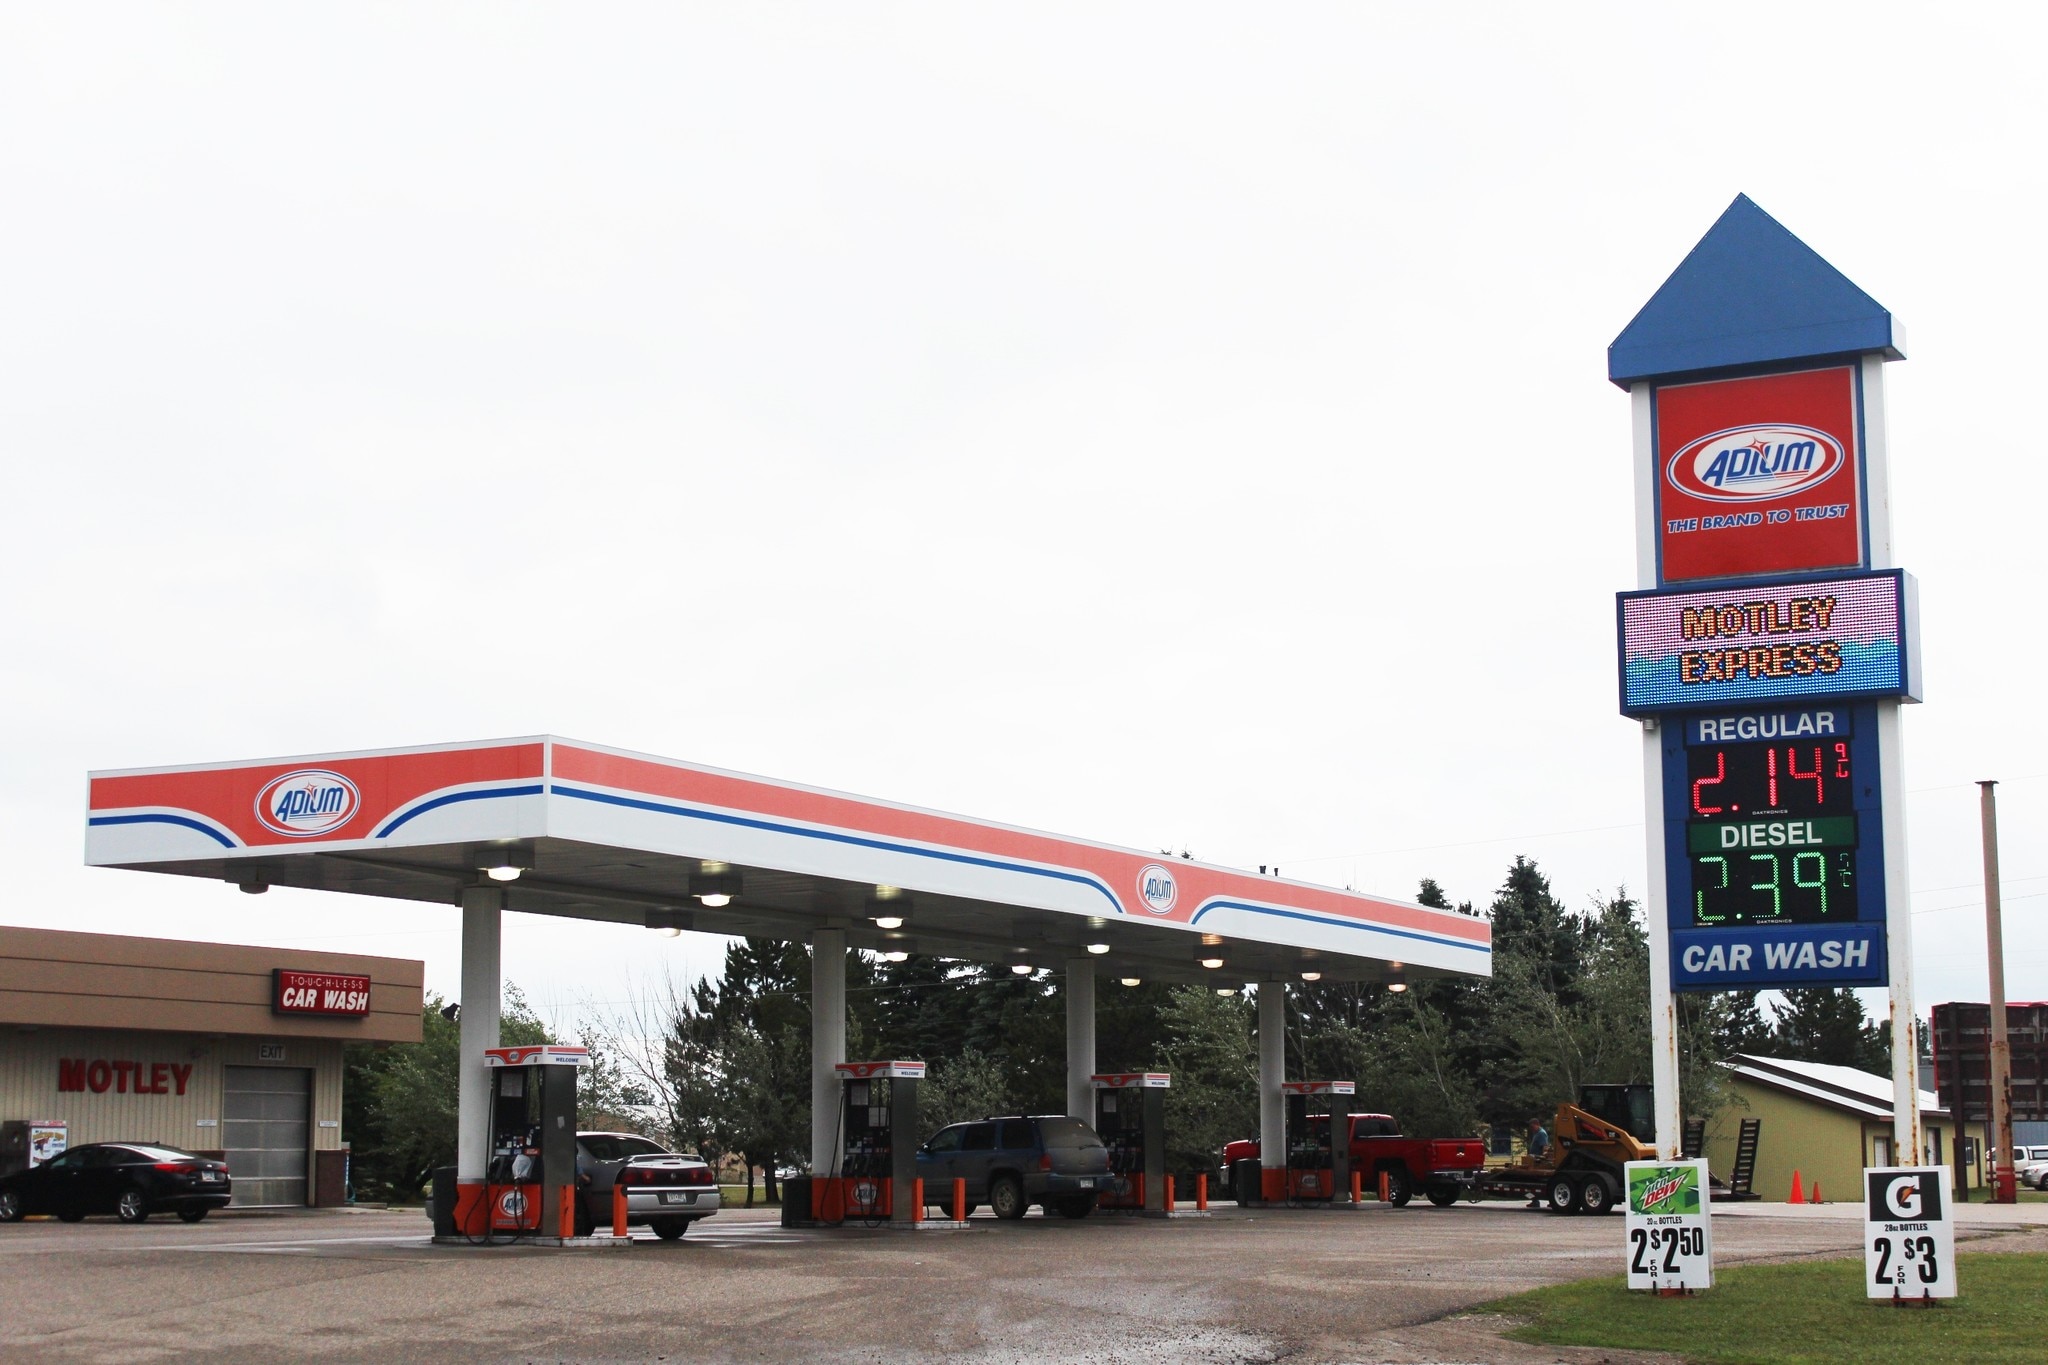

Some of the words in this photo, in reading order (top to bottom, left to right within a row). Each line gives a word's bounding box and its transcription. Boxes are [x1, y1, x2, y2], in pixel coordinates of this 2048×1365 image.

[1702, 440, 1816, 486] ADIUM
[1667, 519, 1697, 534] THE
[1701, 513, 1762, 531] BRAND
[1767, 509, 1790, 524] TO
[1795, 504, 1848, 520] TRUST
[1682, 595, 1836, 640] MOTLEY
[1680, 641, 1842, 685] EXPRESS
[1699, 711, 1835, 742] REGULAR
[275, 786, 344, 822] ADIUM
[1721, 822, 1823, 848] DIESEL
[1145, 877, 1172, 901] ADIUM
[1682, 944, 1752, 973] CAR
[1763, 939, 1869, 971] WASH
[282, 987, 318, 1008] CAR
[323, 989, 368, 1011] WASH
[260, 1044, 284, 1059] EXIT
[58, 1057, 193, 1096] MOTLEY
[1886, 1176, 1922, 1218] G
[1658, 1216, 1683, 1225] BOTTLES
[1899, 1223, 1928, 1231] BOTTLES
[1631, 1228, 1648, 1274] 2
[1874, 1237, 1893, 1284] 2
[1897, 1265, 1905, 1284] FOR
